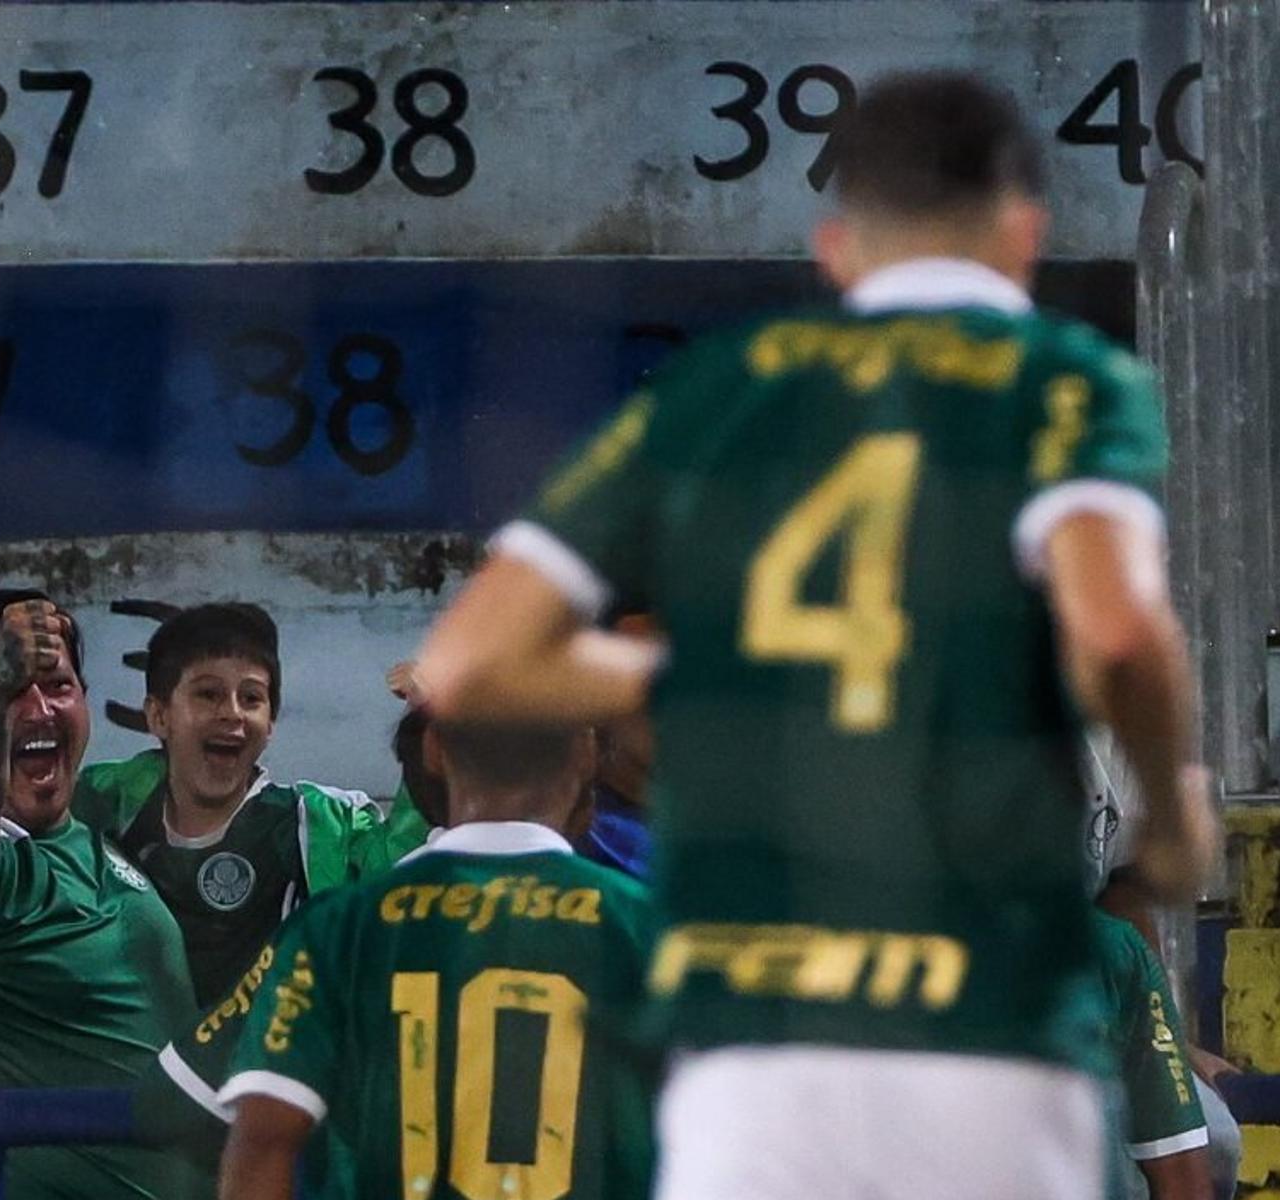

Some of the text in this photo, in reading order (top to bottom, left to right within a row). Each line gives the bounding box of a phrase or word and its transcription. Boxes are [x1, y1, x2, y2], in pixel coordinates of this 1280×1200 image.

[303, 67, 477, 197] 38
[230, 330, 417, 475] 38
[740, 430, 916, 733] 4
[382, 876, 603, 932] crefisa
